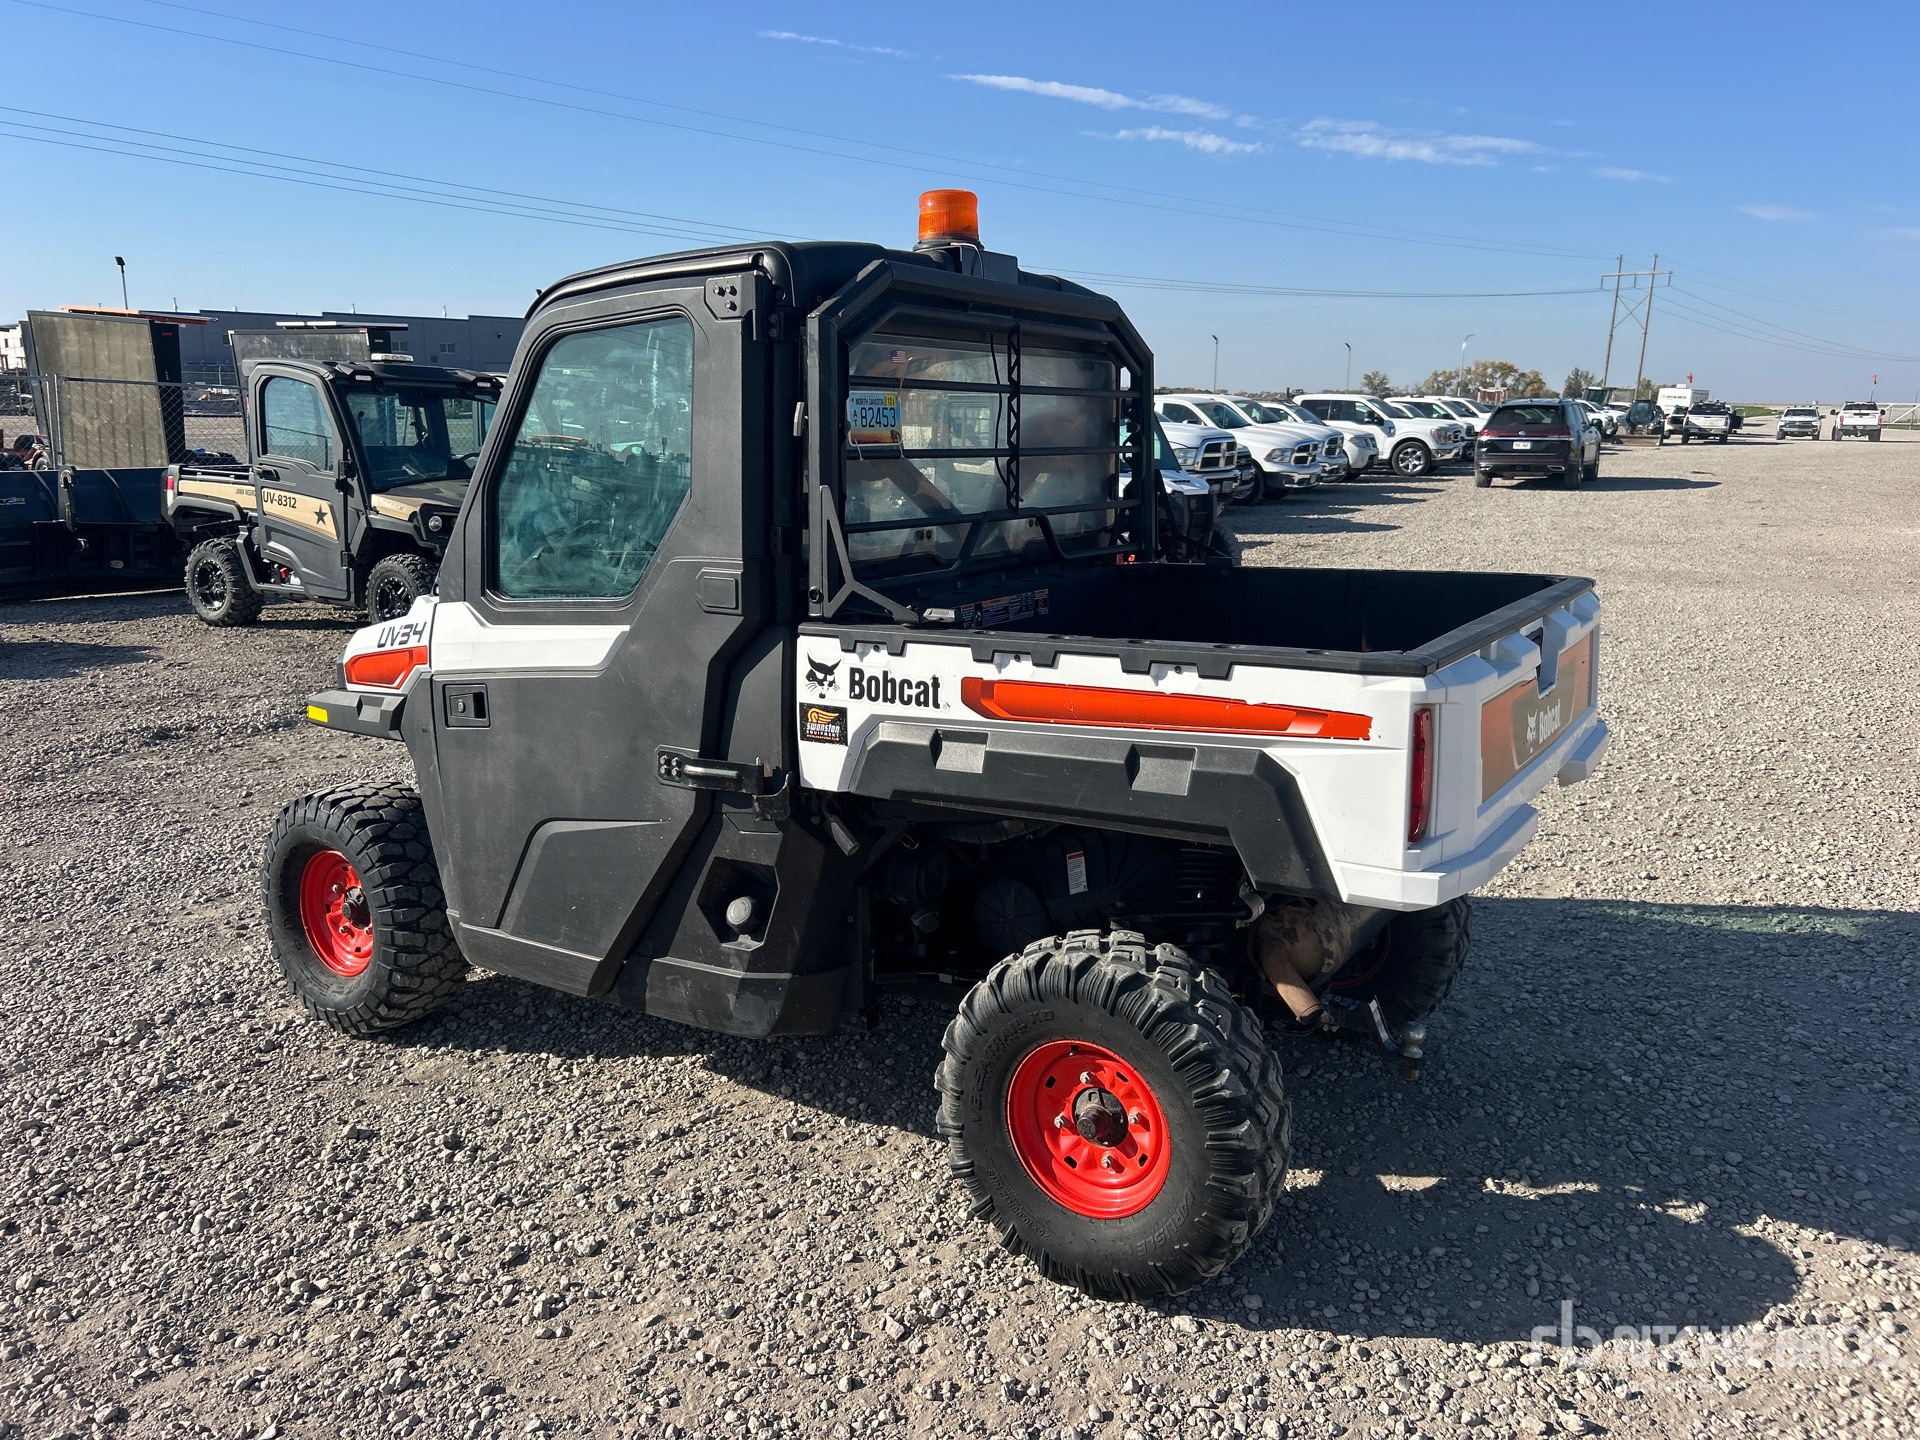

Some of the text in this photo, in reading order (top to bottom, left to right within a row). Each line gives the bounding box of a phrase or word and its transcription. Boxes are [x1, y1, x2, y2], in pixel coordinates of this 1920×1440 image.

[860, 407, 896, 428] 82453
[262, 491, 297, 509] UV-8312
[377, 621, 427, 648] UV34
[849, 667, 940, 709] Bobcat
[806, 730, 840, 738] EQUIPMENT
[1539, 699, 1561, 744] Bobcat
[1136, 1187, 1196, 1257] CARLISLE
